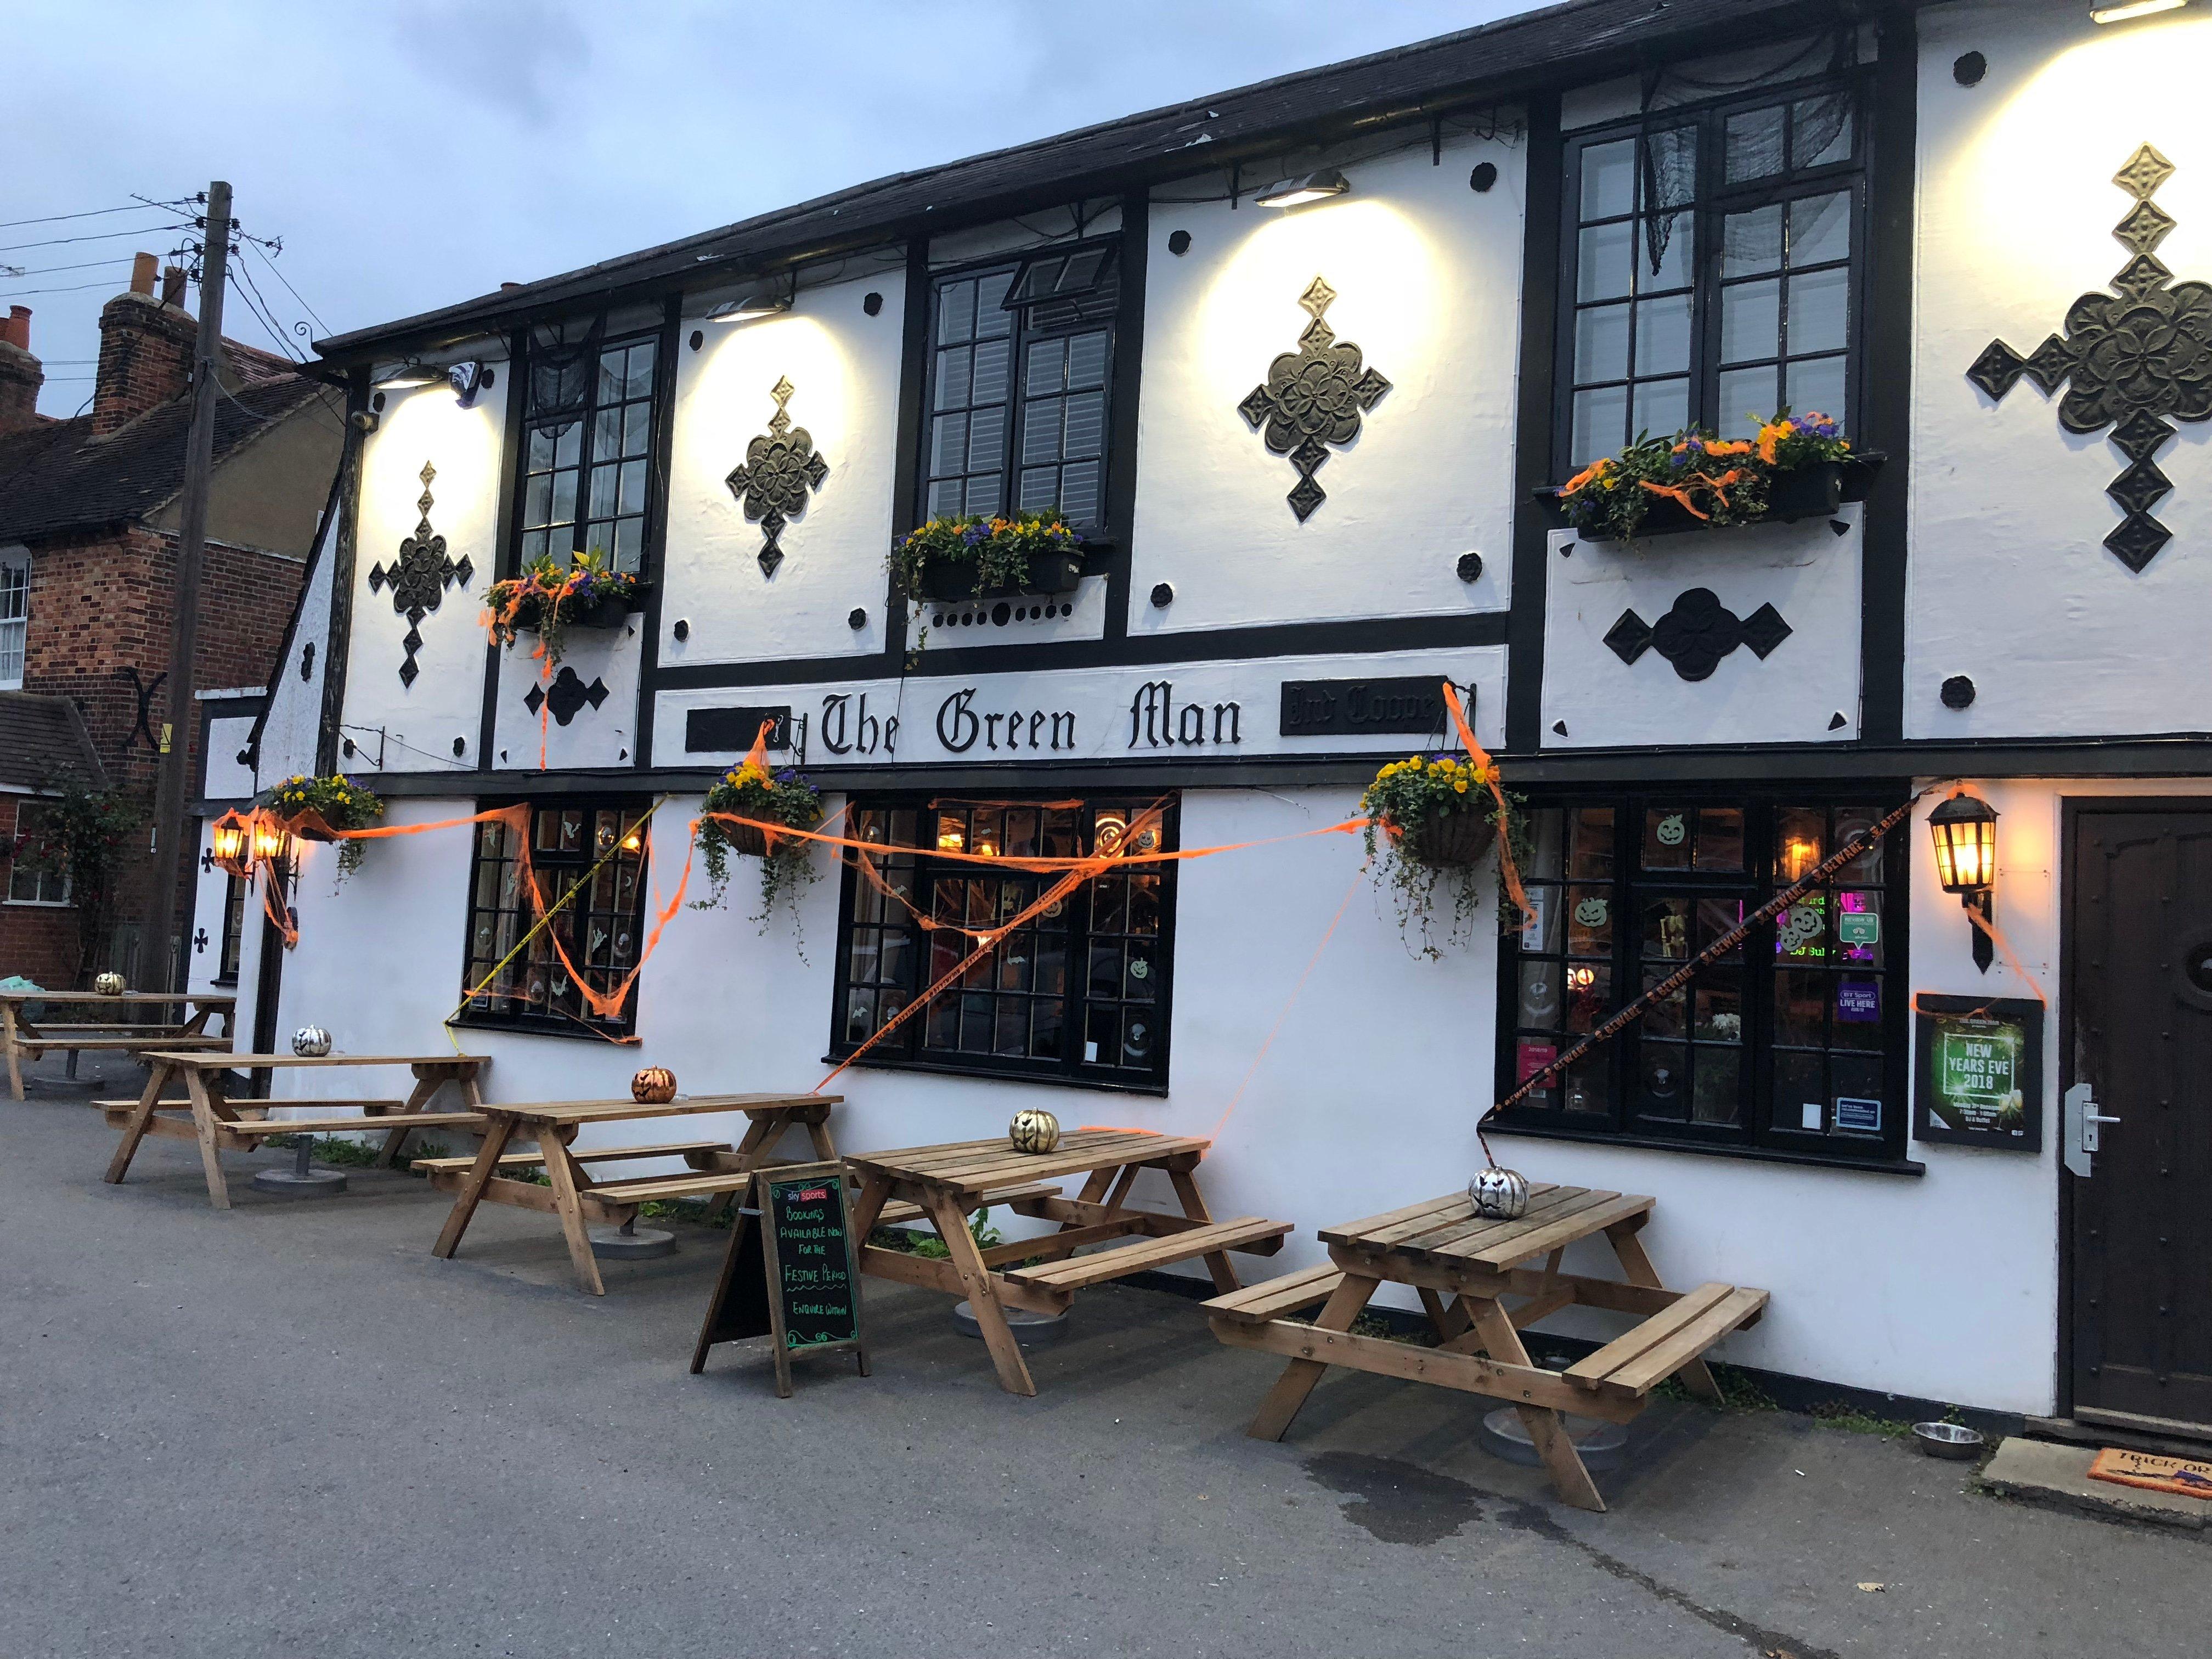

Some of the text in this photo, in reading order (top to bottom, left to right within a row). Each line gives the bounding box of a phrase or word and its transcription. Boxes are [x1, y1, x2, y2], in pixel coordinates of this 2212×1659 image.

[821, 680, 1241, 755] The Green Man
[1822, 840, 1864, 872] BEWARE
[1765, 885, 1807, 916] BEWARE
[1710, 926, 1750, 956] BEWARE
[1657, 964, 1695, 996] BEWARE
[1839, 999, 1876, 1008] LIVE HERE
[1604, 1005, 1642, 1034] BEWARE
[1553, 1042, 1588, 1070] BEWARE
[1966, 1042, 1992, 1058] NEW
[1949, 1057, 2009, 1075] YEARS EVE
[1964, 1074, 1994, 1090] 2018
[1505, 1080, 1537, 1106] BEWARE
[788, 1191, 826, 1201] sky sports
[780, 1227, 842, 1239] AVAILABLE NOW
[798, 1244, 826, 1255] FOR THE
[785, 1263, 847, 1283] FESTIVE PERIOD
[793, 1301, 847, 1316] ENQUIRE WITHIN
[2120, 1453, 2209, 1474] TRICK OR
